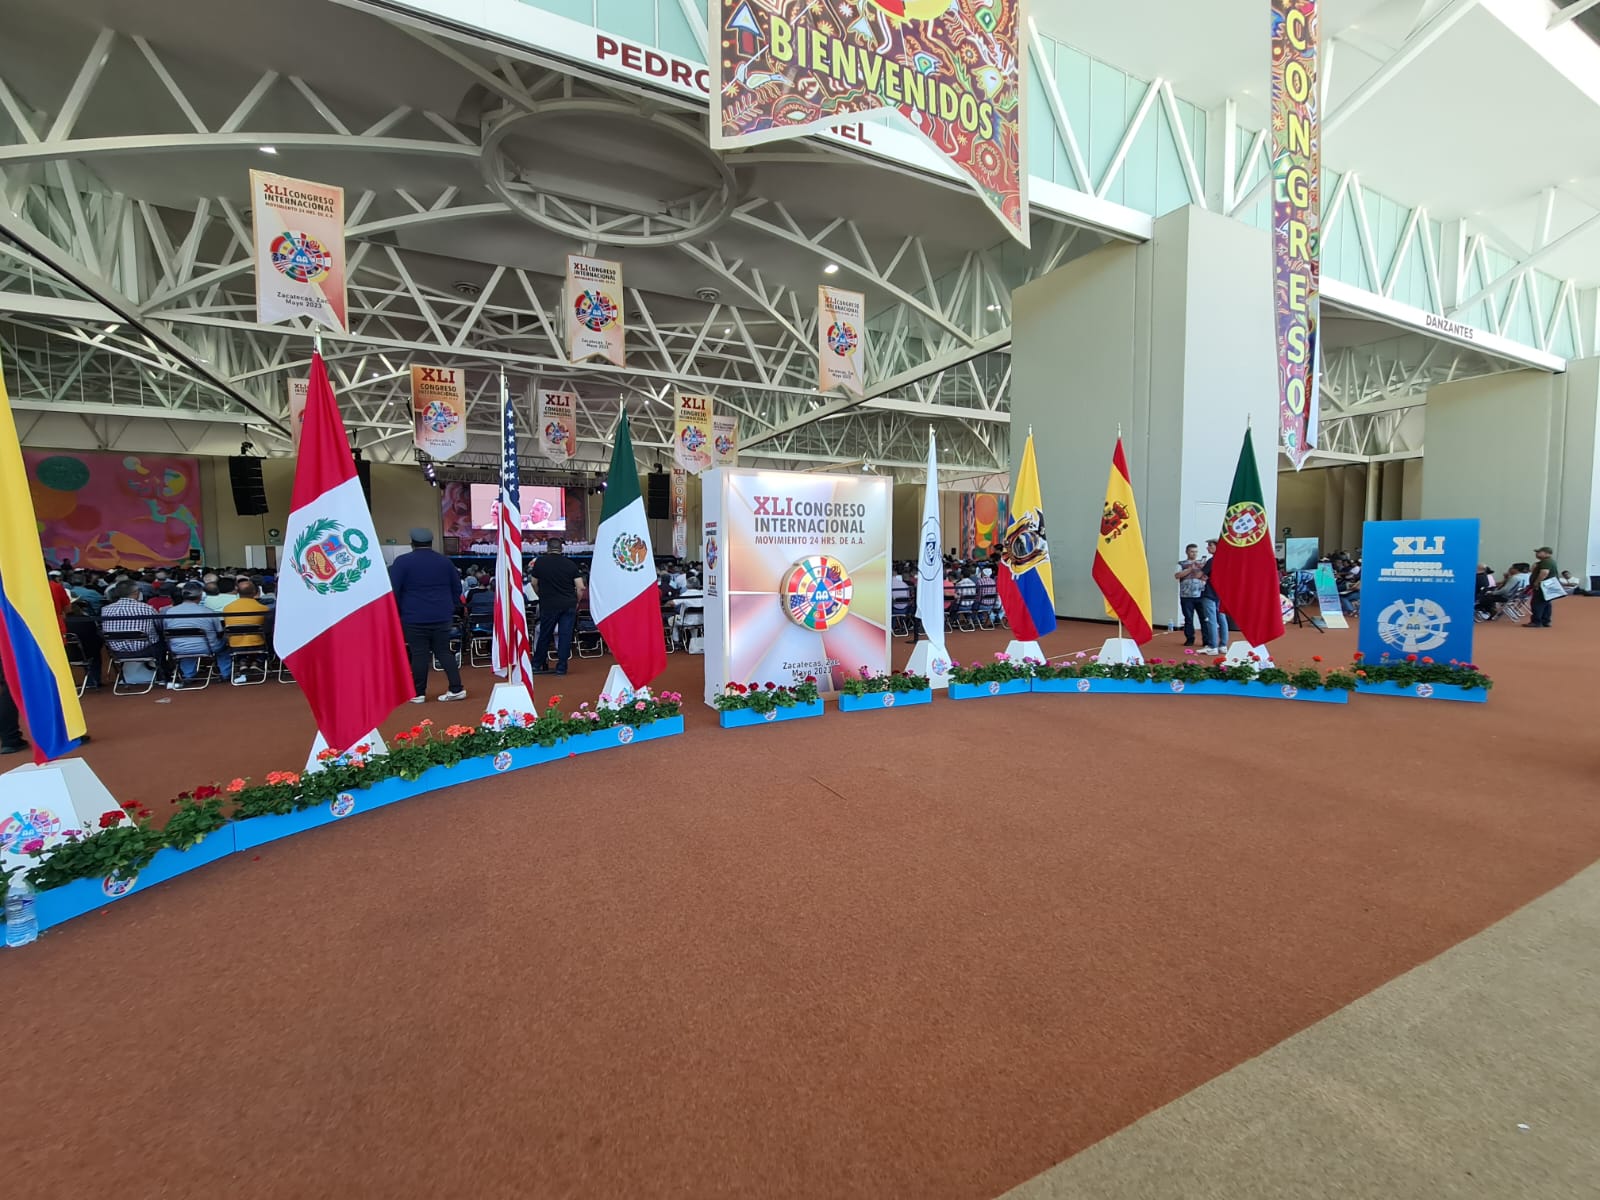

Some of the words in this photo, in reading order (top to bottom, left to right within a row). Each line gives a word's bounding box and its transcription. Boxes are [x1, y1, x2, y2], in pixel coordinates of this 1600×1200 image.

[770, 16, 994, 140] BIENVENIDOS
[264, 184, 288, 197] XLI
[289, 190, 334, 206] CONGRESO
[265, 193, 334, 213] INTERNACIONAL
[1285, 9, 1311, 415] CONGRESO
[574, 262, 588, 271] XLI
[1426, 315, 1474, 339] DANZANTES
[421, 368, 455, 384] XLI
[420, 383, 457, 393] CONGRESO
[545, 394, 569, 407] XLI
[681, 396, 706, 410] XLI
[753, 495, 793, 516] XLI
[795, 502, 866, 517] CONGRESO
[755, 517, 866, 534] INTERNACIONAL
[755, 535, 808, 545] MOVIMIENTO
[810, 537, 819, 545] 24
[840, 537, 849, 545] DE
[1392, 536, 1446, 555] XLI
[816, 591, 829, 601] AA
